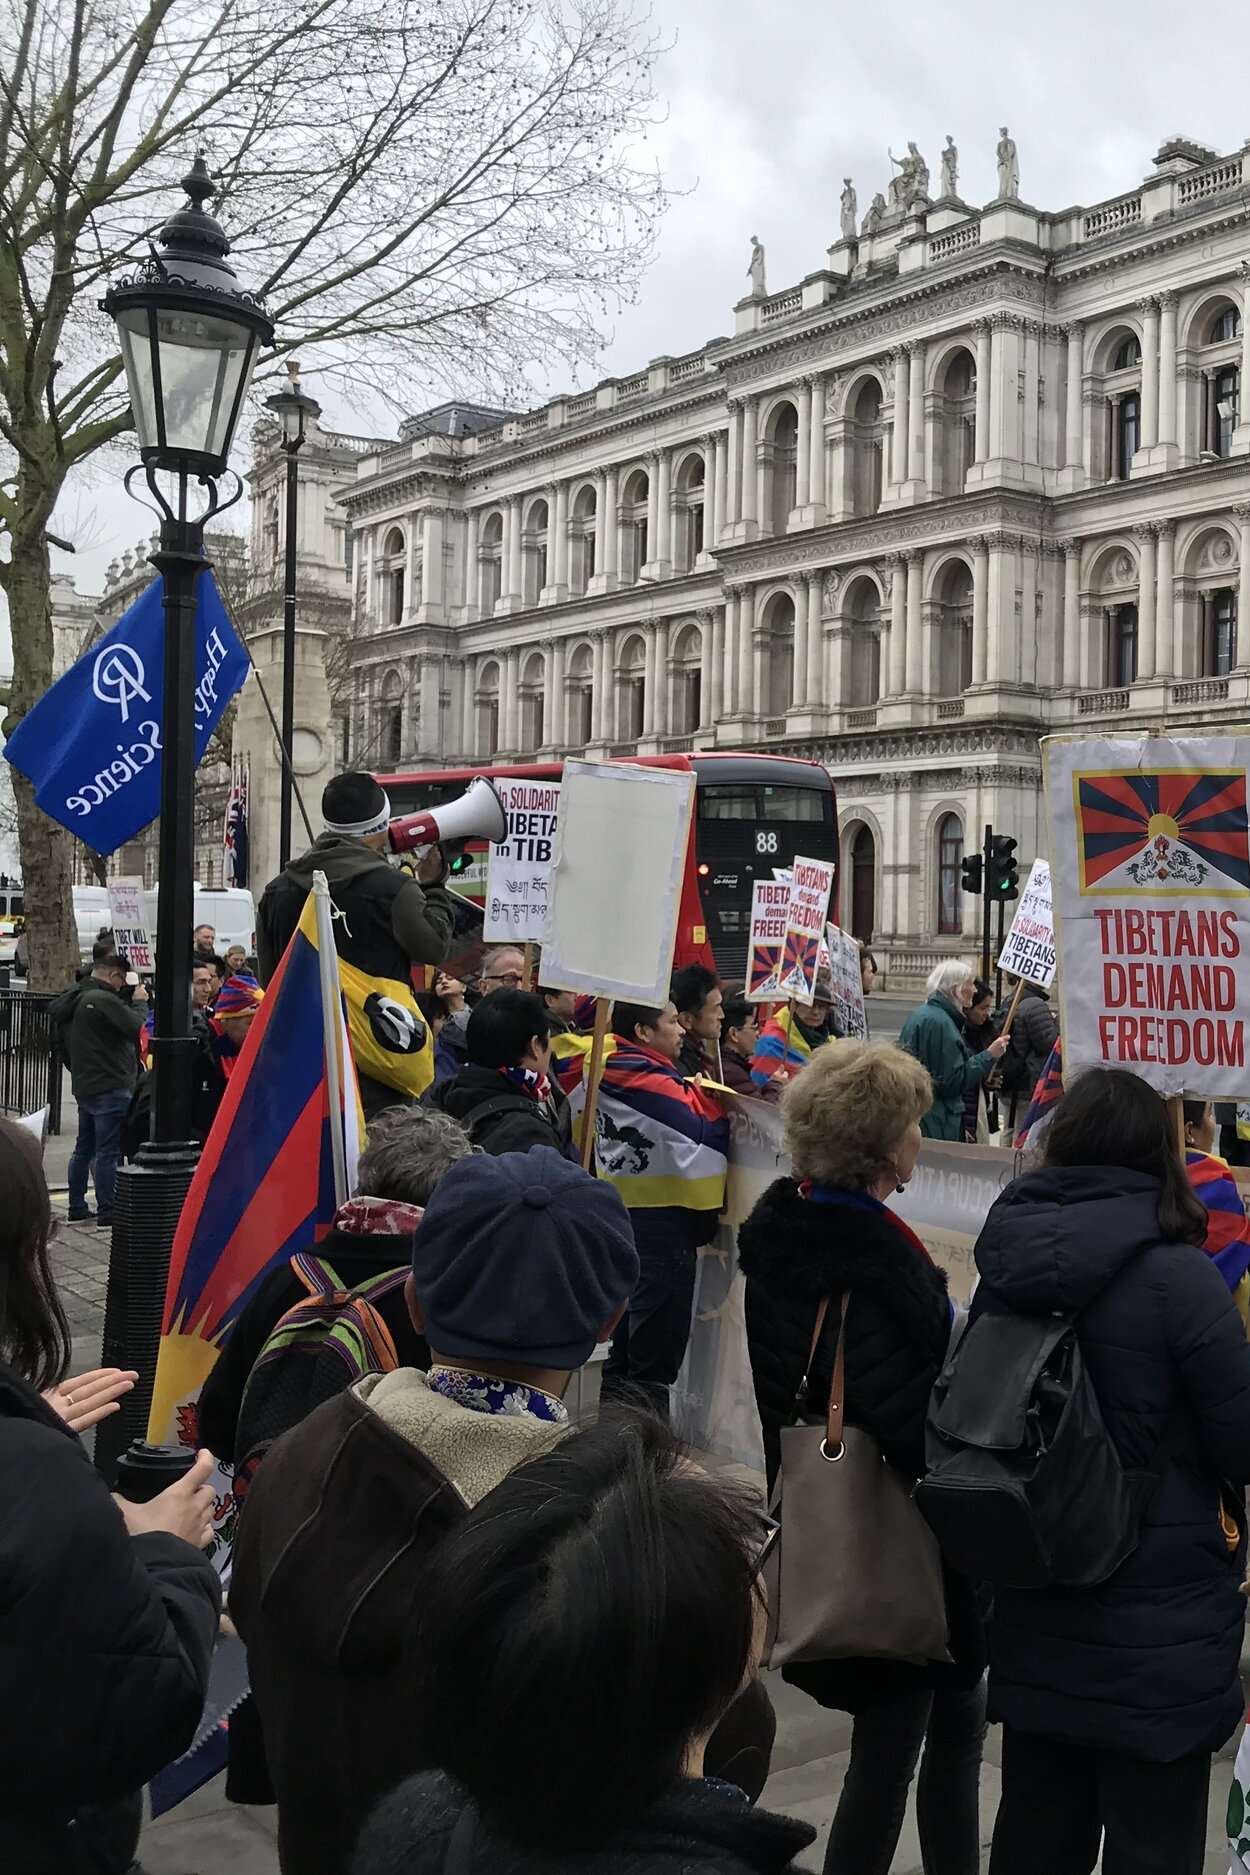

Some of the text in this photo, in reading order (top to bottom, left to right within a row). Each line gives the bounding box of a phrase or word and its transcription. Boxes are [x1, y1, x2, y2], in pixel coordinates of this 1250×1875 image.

[757, 832, 777, 852] 88
[115, 928, 149, 945] TIBET WILL
[1008, 932, 1055, 966] TIBETANS
[1094, 908, 1240, 959] TIBETANS
[129, 946, 152, 967] FREE
[1011, 952, 1052, 982] TIBET
[1103, 962, 1236, 1012] DEMAND
[1099, 1015, 1245, 1068] FREEDOM
